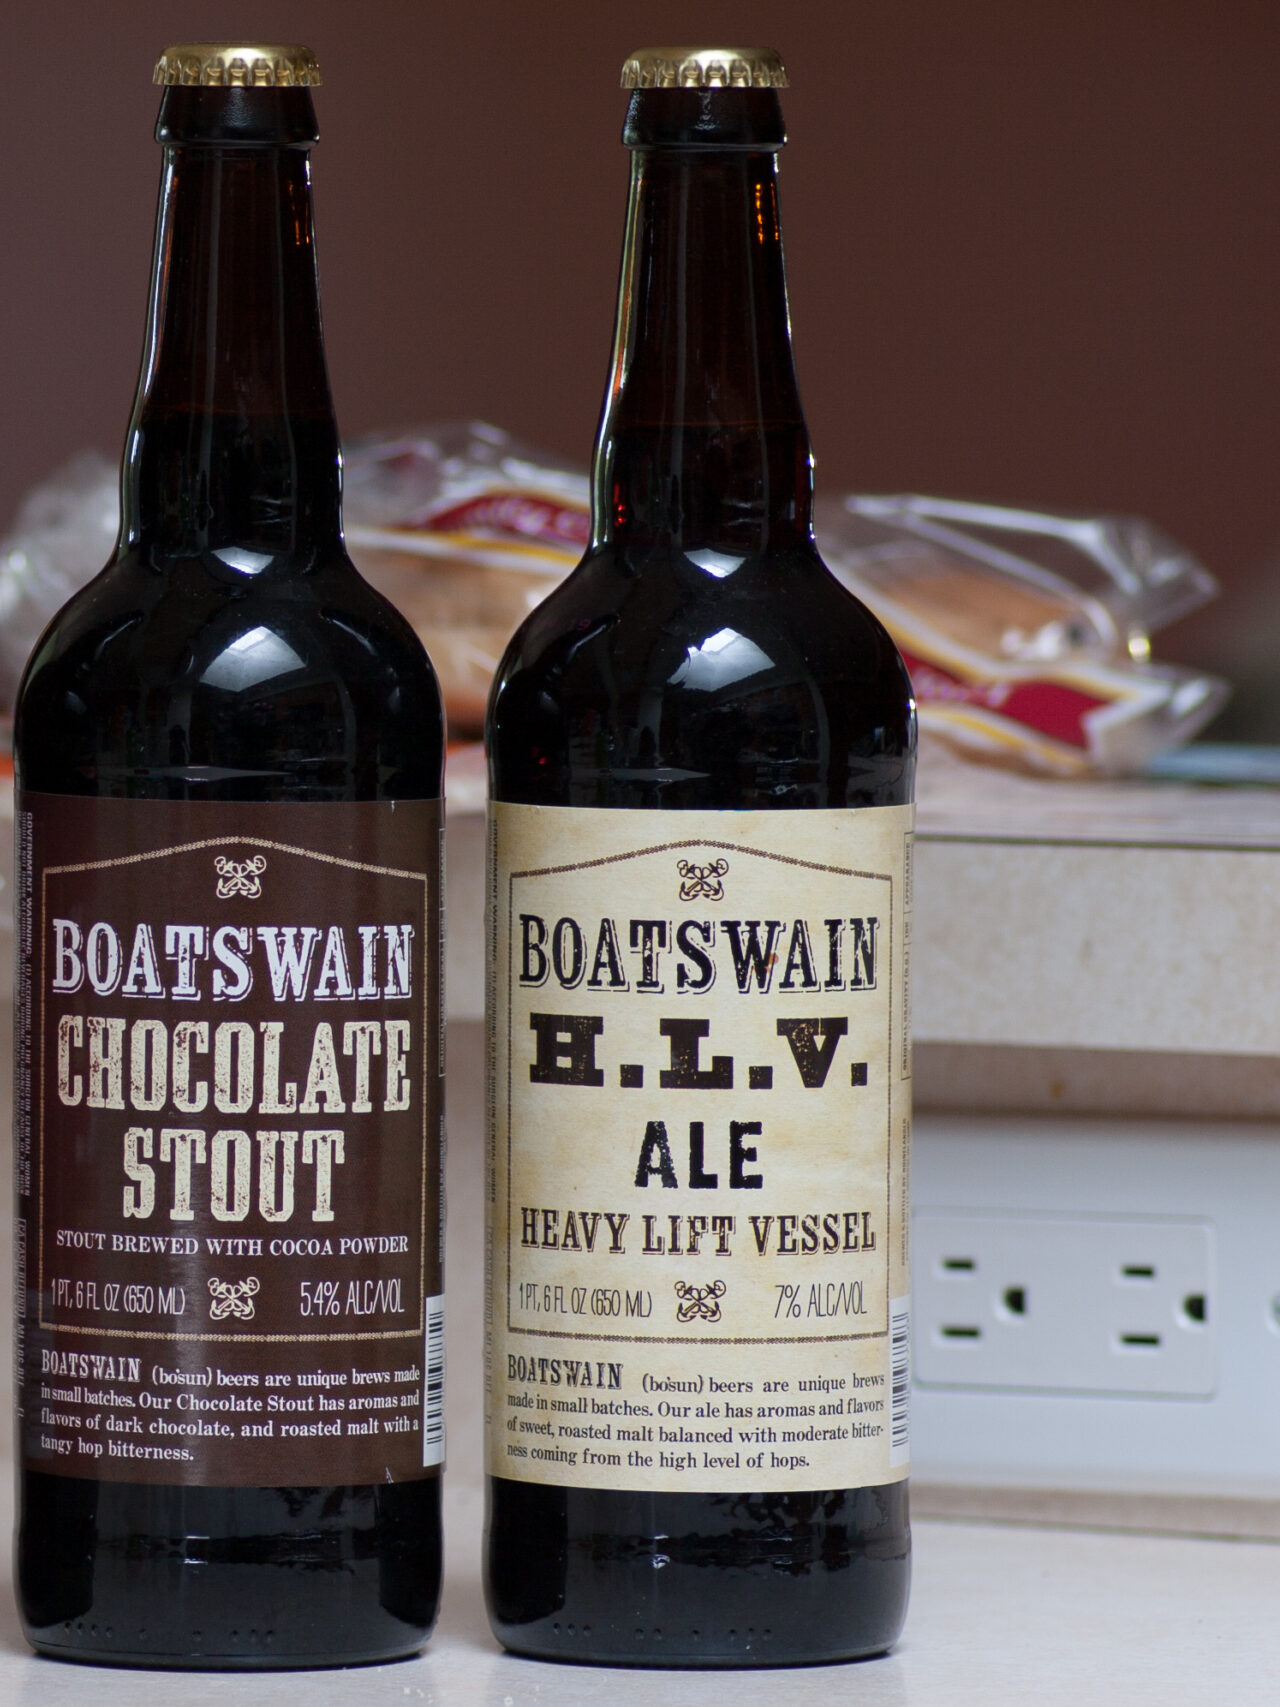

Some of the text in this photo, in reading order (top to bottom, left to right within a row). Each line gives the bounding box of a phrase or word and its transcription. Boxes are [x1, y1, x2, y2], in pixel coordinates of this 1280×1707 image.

[53, 919, 415, 1002] BOATSWAIN
[518, 913, 880, 995] BOATSWAIN
[58, 1015, 410, 1114] CHOCOLATE
[529, 1011, 868, 1090] H.L.V.
[634, 1120, 763, 1189] ALE
[123, 1127, 345, 1222] STOUT
[57, 1230, 408, 1256] STOUT BREWED WITH COCOA POWDER
[520, 1206, 876, 1256] HEAVY LIFT VESSEL
[300, 1281, 340, 1316] 5.4%
[544, 1285, 551, 1312] 6
[554, 1285, 568, 1314] FL
[571, 1287, 587, 1315] OZ
[591, 1288, 621, 1317] (650
[626, 1290, 652, 1318] ML)
[774, 1284, 801, 1318] 7%
[42, 1349, 142, 1382] BOATSWAIN
[216, 1369, 259, 1386] beers
[265, 1369, 291, 1386] are
[297, 1369, 347, 1389] unique
[352, 1368, 390, 1385] brews
[394, 1364, 420, 1382] made
[507, 1353, 623, 1389] BOATSWAIN
[709, 1377, 753, 1393] beers
[763, 1381, 789, 1392] are
[798, 1375, 846, 1394] unique
[853, 1372, 884, 1388] brews
[41, 1407, 419, 1438] flavors of dark chocolate, and roasted malt with a
[507, 1392, 884, 1418] made in small batches. Our ale has aromas and flavors
[41, 1434, 194, 1461] tangy hop bitterness.
[507, 1416, 884, 1443] of sweet, roasted malt balanced with moderate bitter-
[507, 1440, 810, 1471] ness coming from the high level of hops.
